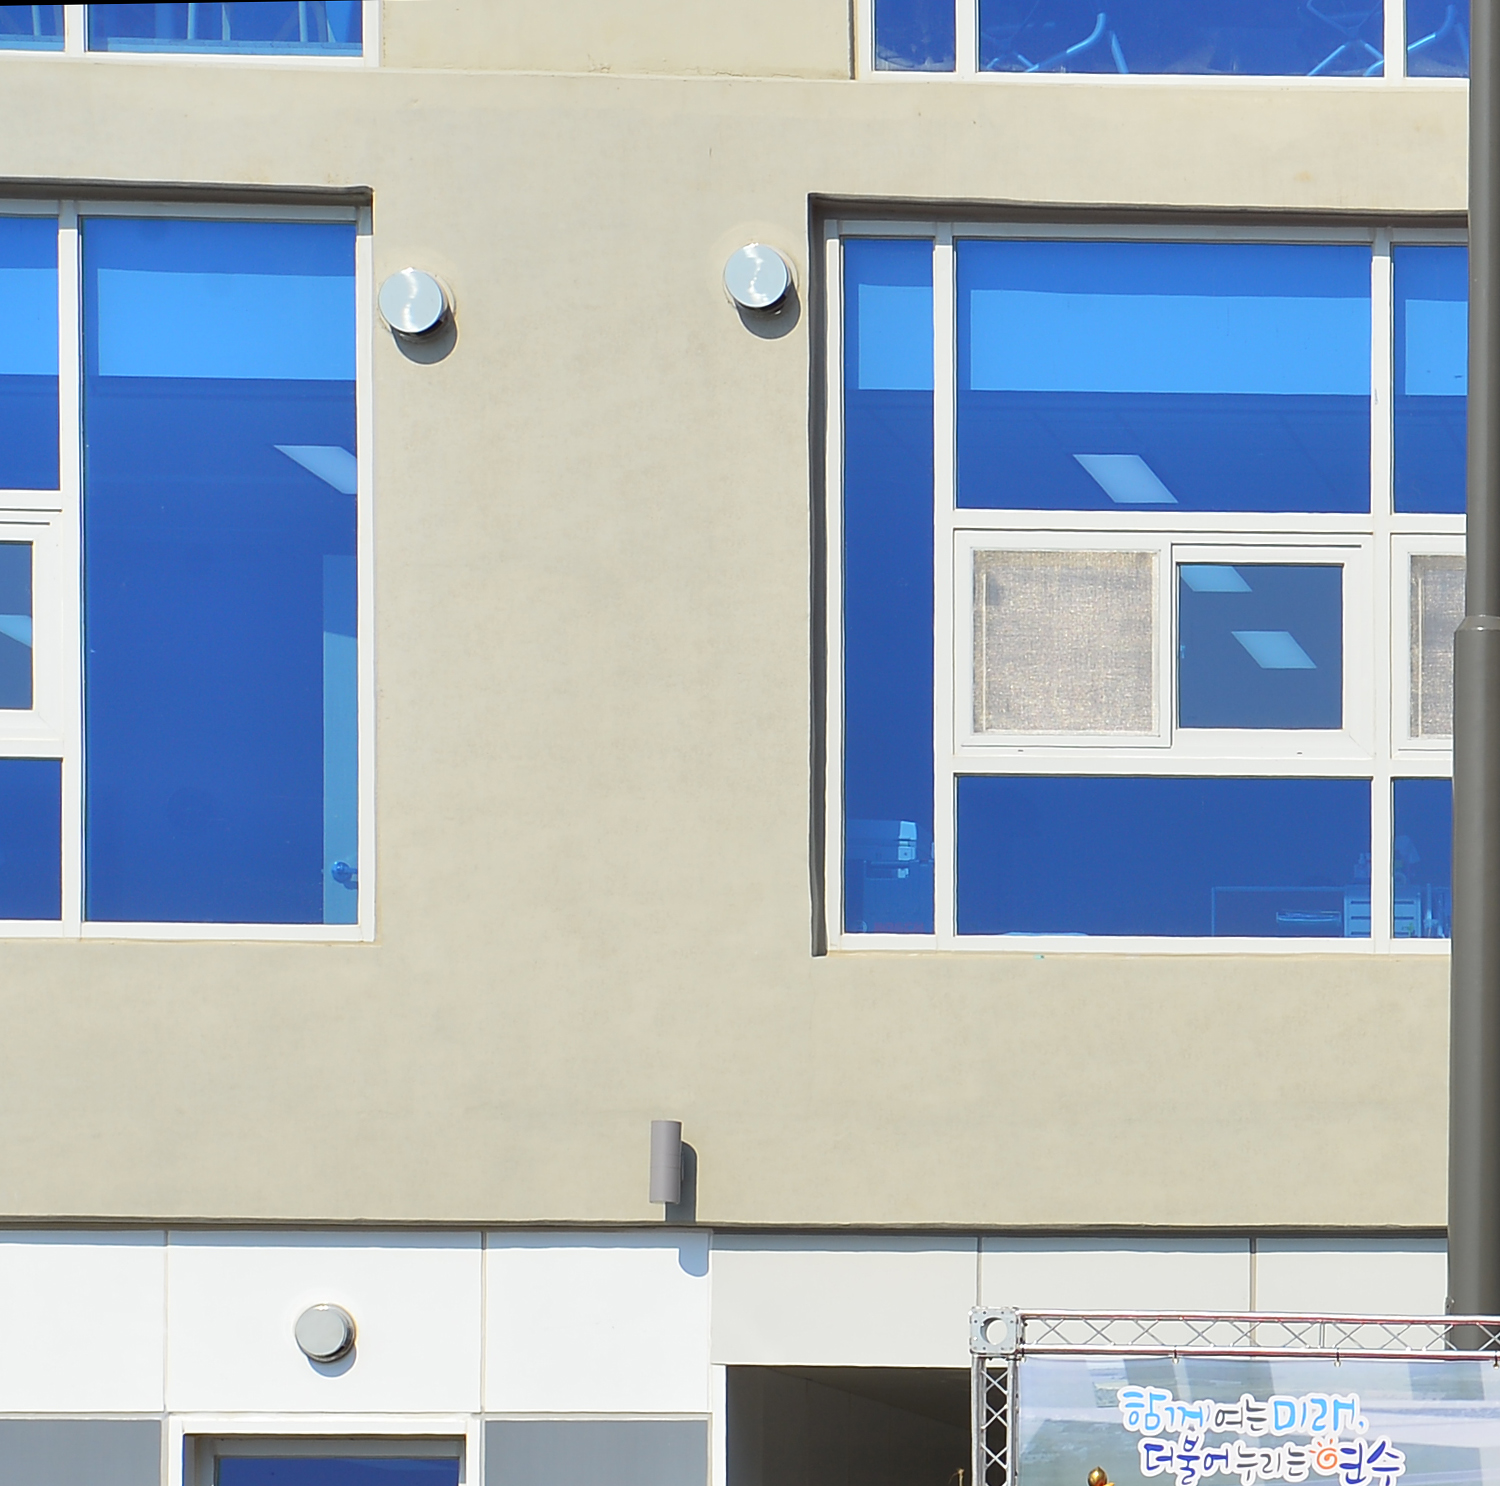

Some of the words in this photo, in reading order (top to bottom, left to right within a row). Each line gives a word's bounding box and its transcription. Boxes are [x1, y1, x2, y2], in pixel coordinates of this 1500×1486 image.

[1123, 1392, 1210, 1430] 함께
[1215, 1399, 1267, 1431] 여는
[1144, 1435, 1228, 1485] 더불어
[1237, 1447, 1306, 1481] 누리는
[1309, 1440, 1400, 1486] 연수
